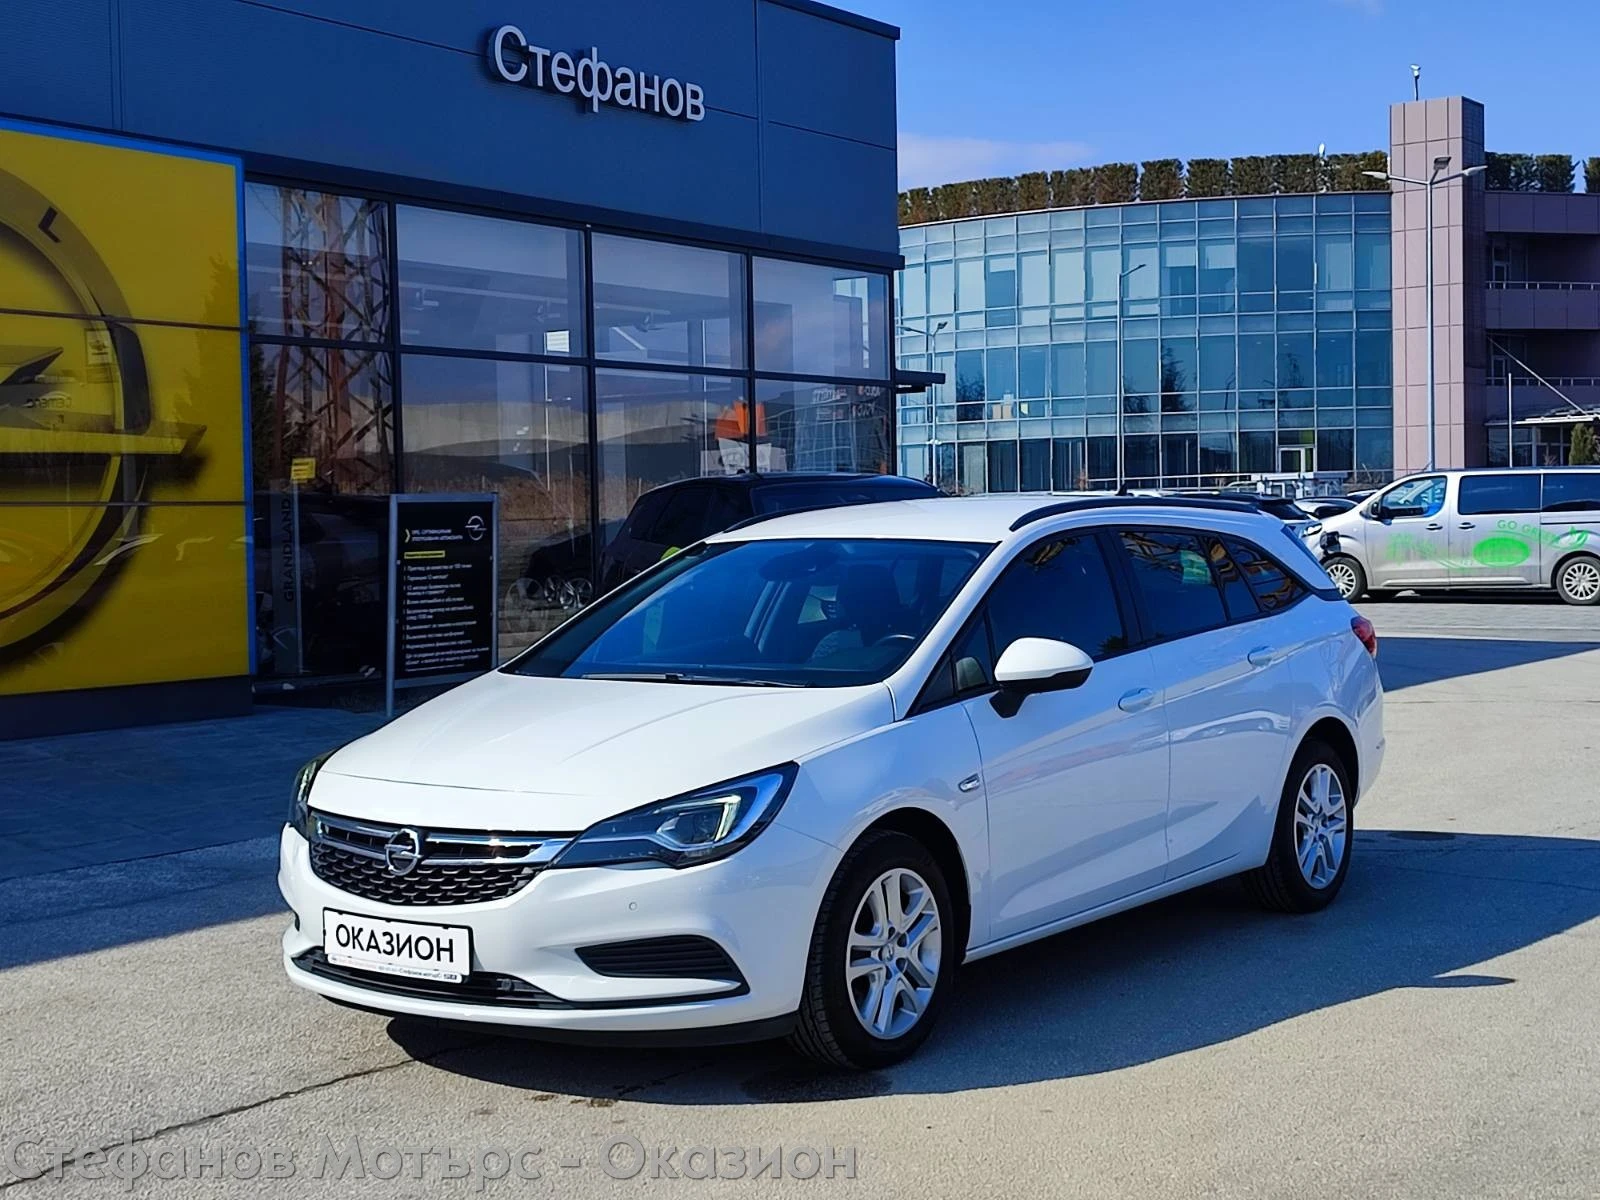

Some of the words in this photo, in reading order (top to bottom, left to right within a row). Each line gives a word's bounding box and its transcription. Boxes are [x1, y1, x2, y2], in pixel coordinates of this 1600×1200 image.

[494, 24, 706, 121] Стефанов
[281, 497, 294, 602] GRANDLAND
[1497, 519, 1518, 530] GO
[335, 923, 454, 963] ОКАЗИОН
